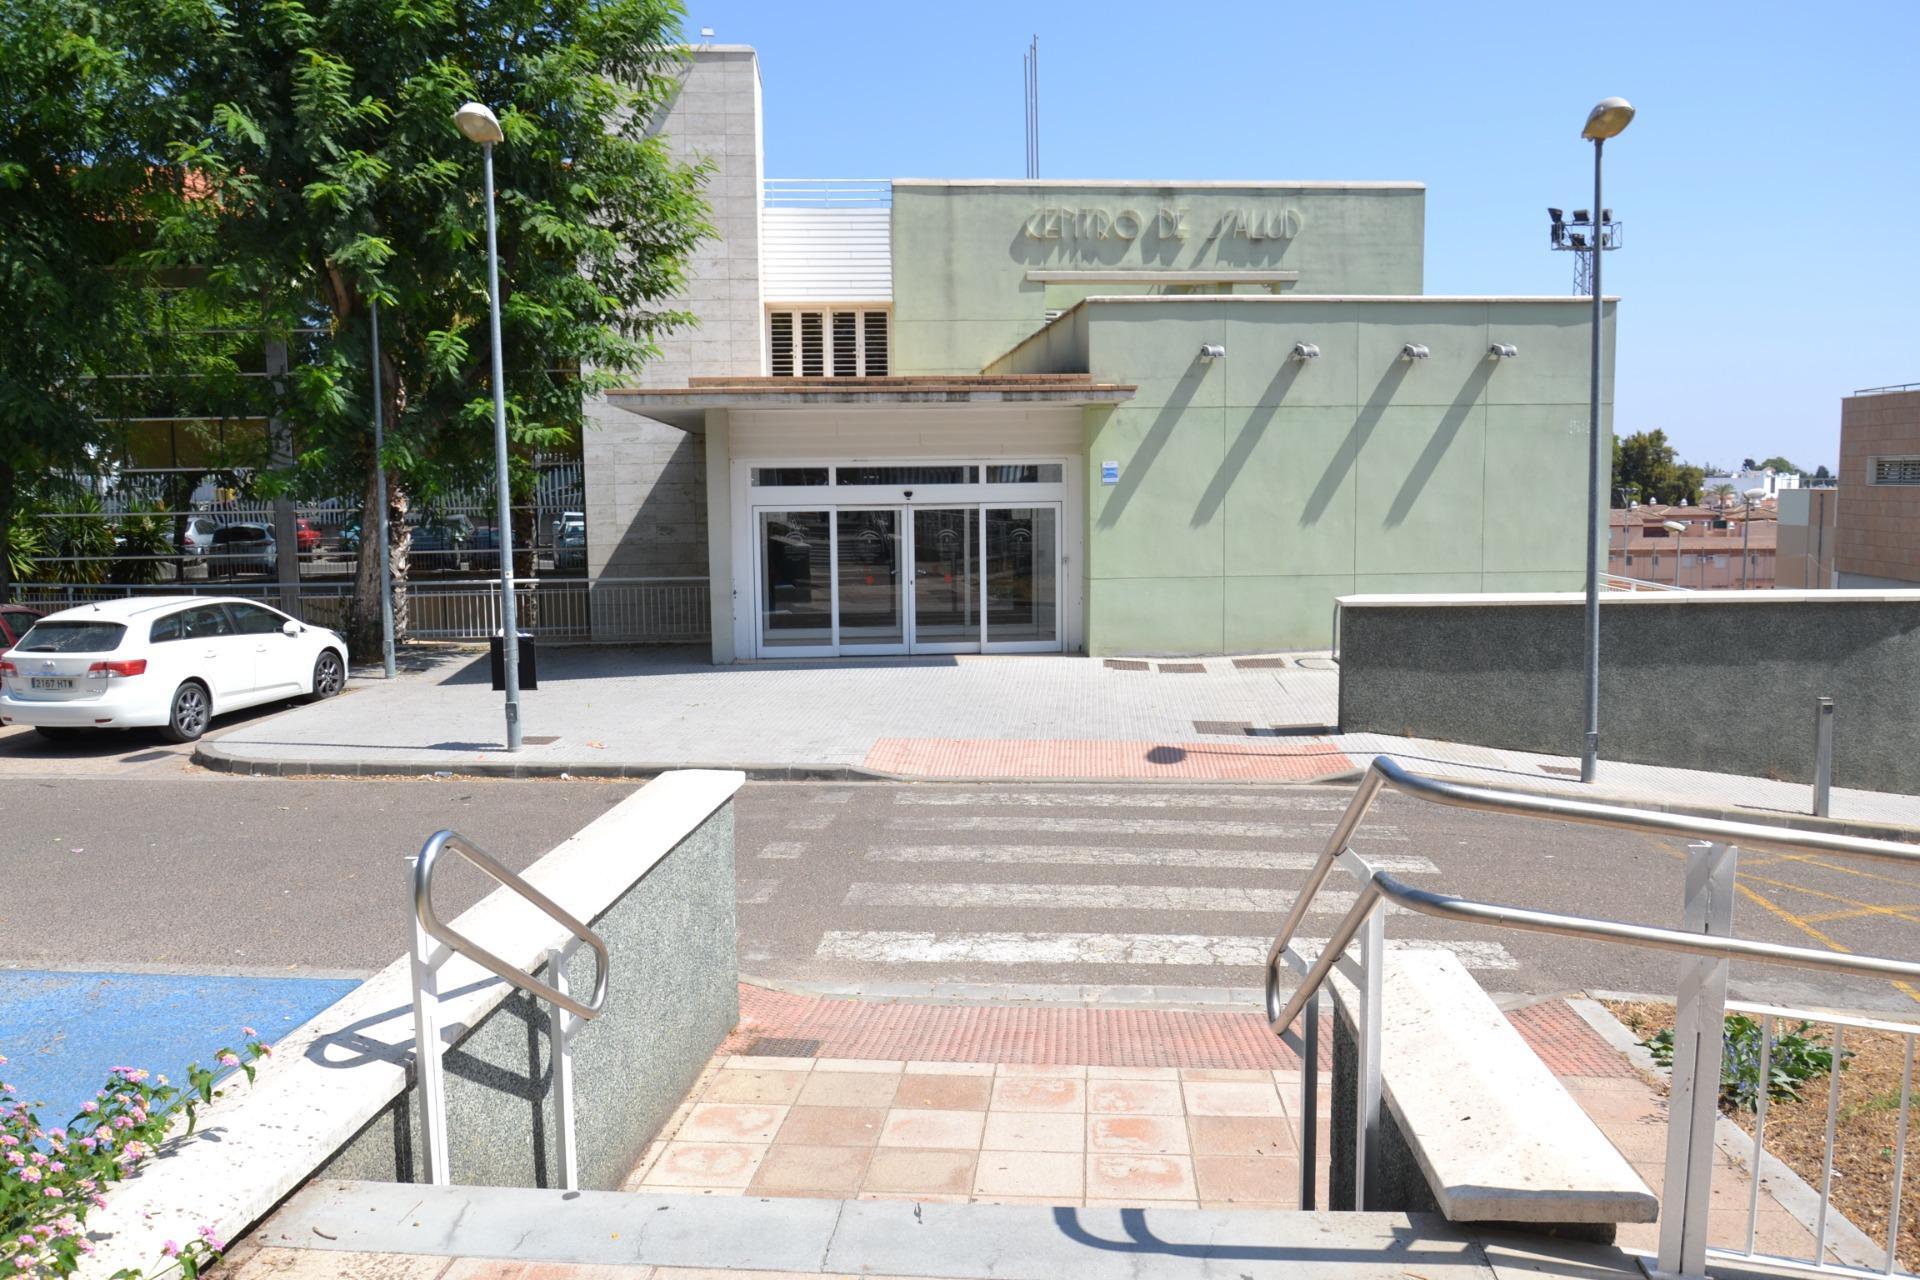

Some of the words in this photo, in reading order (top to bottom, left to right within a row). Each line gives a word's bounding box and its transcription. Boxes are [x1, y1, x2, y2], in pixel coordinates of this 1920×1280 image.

[1025, 207, 1145, 240] CENTRO
[1158, 207, 1191, 240] DE
[1204, 207, 1302, 240] SALUD
